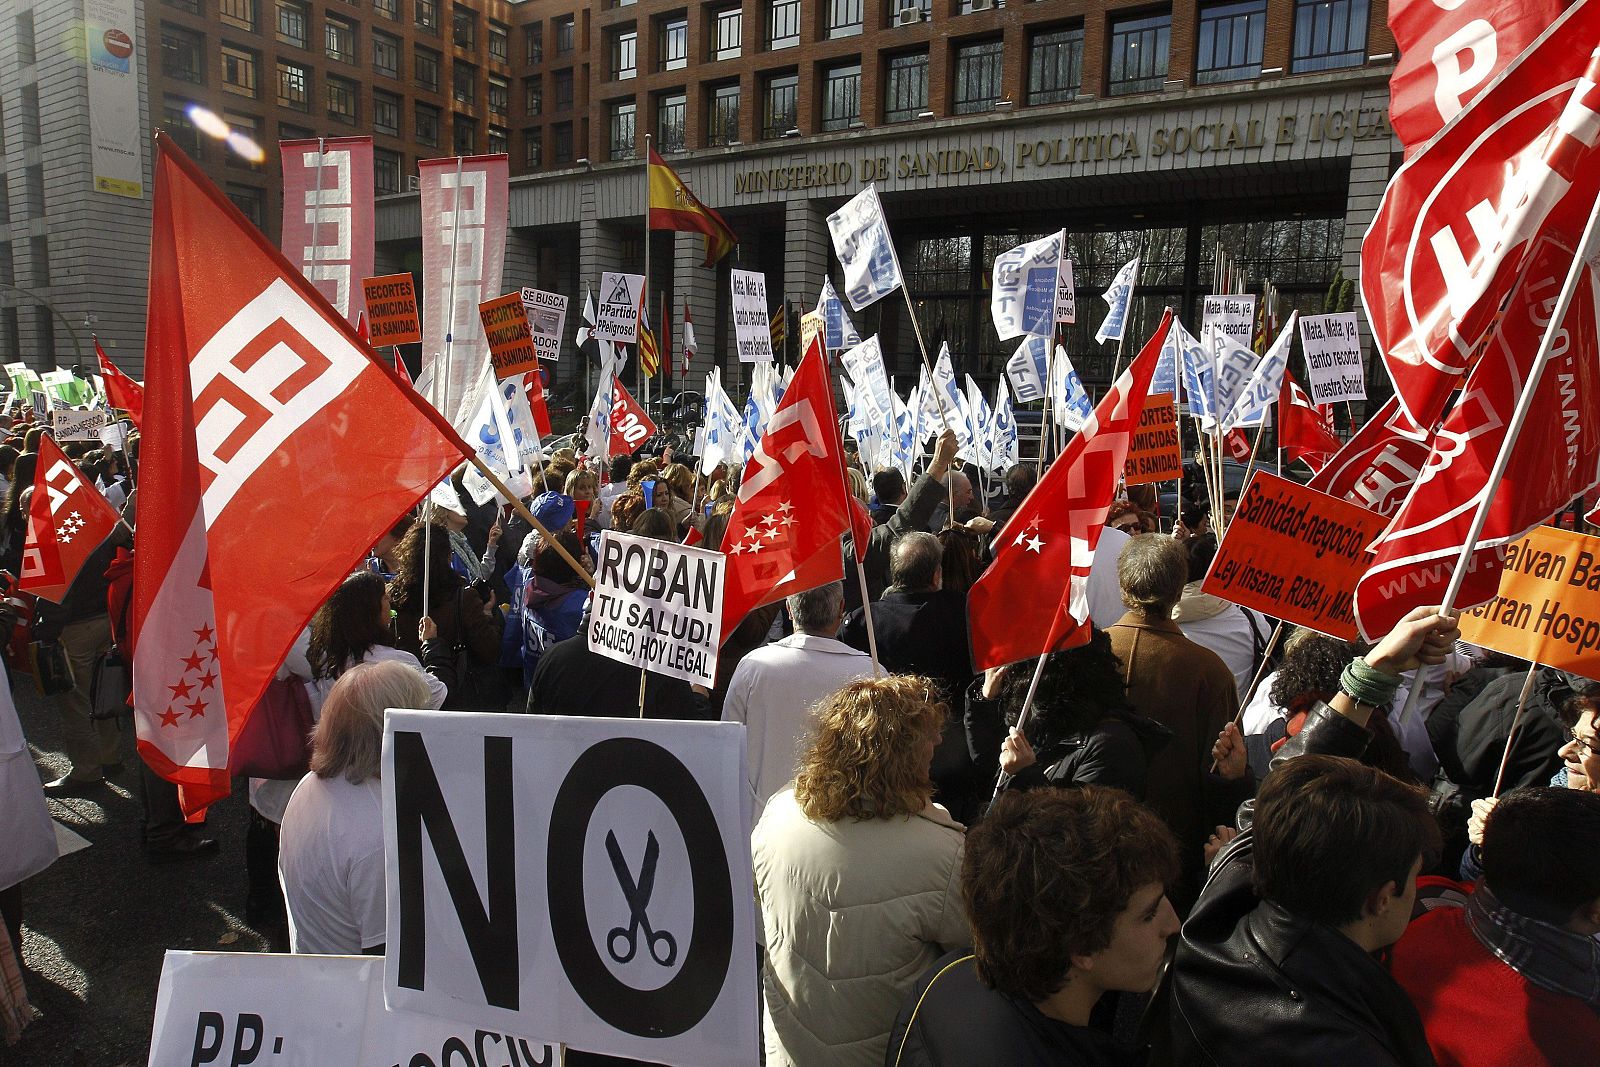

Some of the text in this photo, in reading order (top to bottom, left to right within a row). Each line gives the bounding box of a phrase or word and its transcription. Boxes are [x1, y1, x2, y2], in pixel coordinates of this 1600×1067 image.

[734, 106, 1393, 196] MINISTERIO DE SANIDAD, POLITICA SOCIAL E IGUA
[364, 282, 412, 301] RECORTES
[523, 289, 565, 309] SE BUSCA
[1059, 289, 1074, 301] tido
[367, 300, 415, 319] HOMICIDAS
[479, 300, 525, 328] RECORTES
[600, 304, 637, 320] PPartido
[1205, 300, 1252, 317] Mata, Mata, ya,
[371, 319, 419, 338] EN SANIDAD.
[485, 321, 531, 349] HOMICIDAS
[597, 319, 636, 337] PPeligroso!
[1222, 321, 1251, 335] recortar
[1303, 318, 1357, 342] Mata, Mata, ya,
[532, 335, 558, 350] ADOR
[491, 352, 504, 369] EN
[536, 349, 558, 360] erie.
[1308, 347, 1360, 370] tanto recortar
[1314, 377, 1343, 399] nuestra
[1137, 405, 1175, 427] ORTES
[87, 429, 99, 439] NO
[1129, 428, 1179, 453] OMICIDAS
[1125, 458, 1138, 477] EN
[1238, 481, 1364, 567] Sanidad-negocio,
[1503, 539, 1567, 582] alvan
[600, 538, 718, 614] ROBAN
[1212, 549, 1240, 590] Ley
[1237, 558, 1286, 605] insana,
[1284, 575, 1324, 611] ROBA
[1314, 595, 1329, 621] y
[599, 593, 713, 648] TU SALUD!
[1533, 599, 1600, 655] Hosp
[591, 620, 636, 661] SAQUEO,
[639, 635, 668, 665] HOY
[667, 643, 712, 680] LEGAL.
[393, 730, 735, 1039] NO
